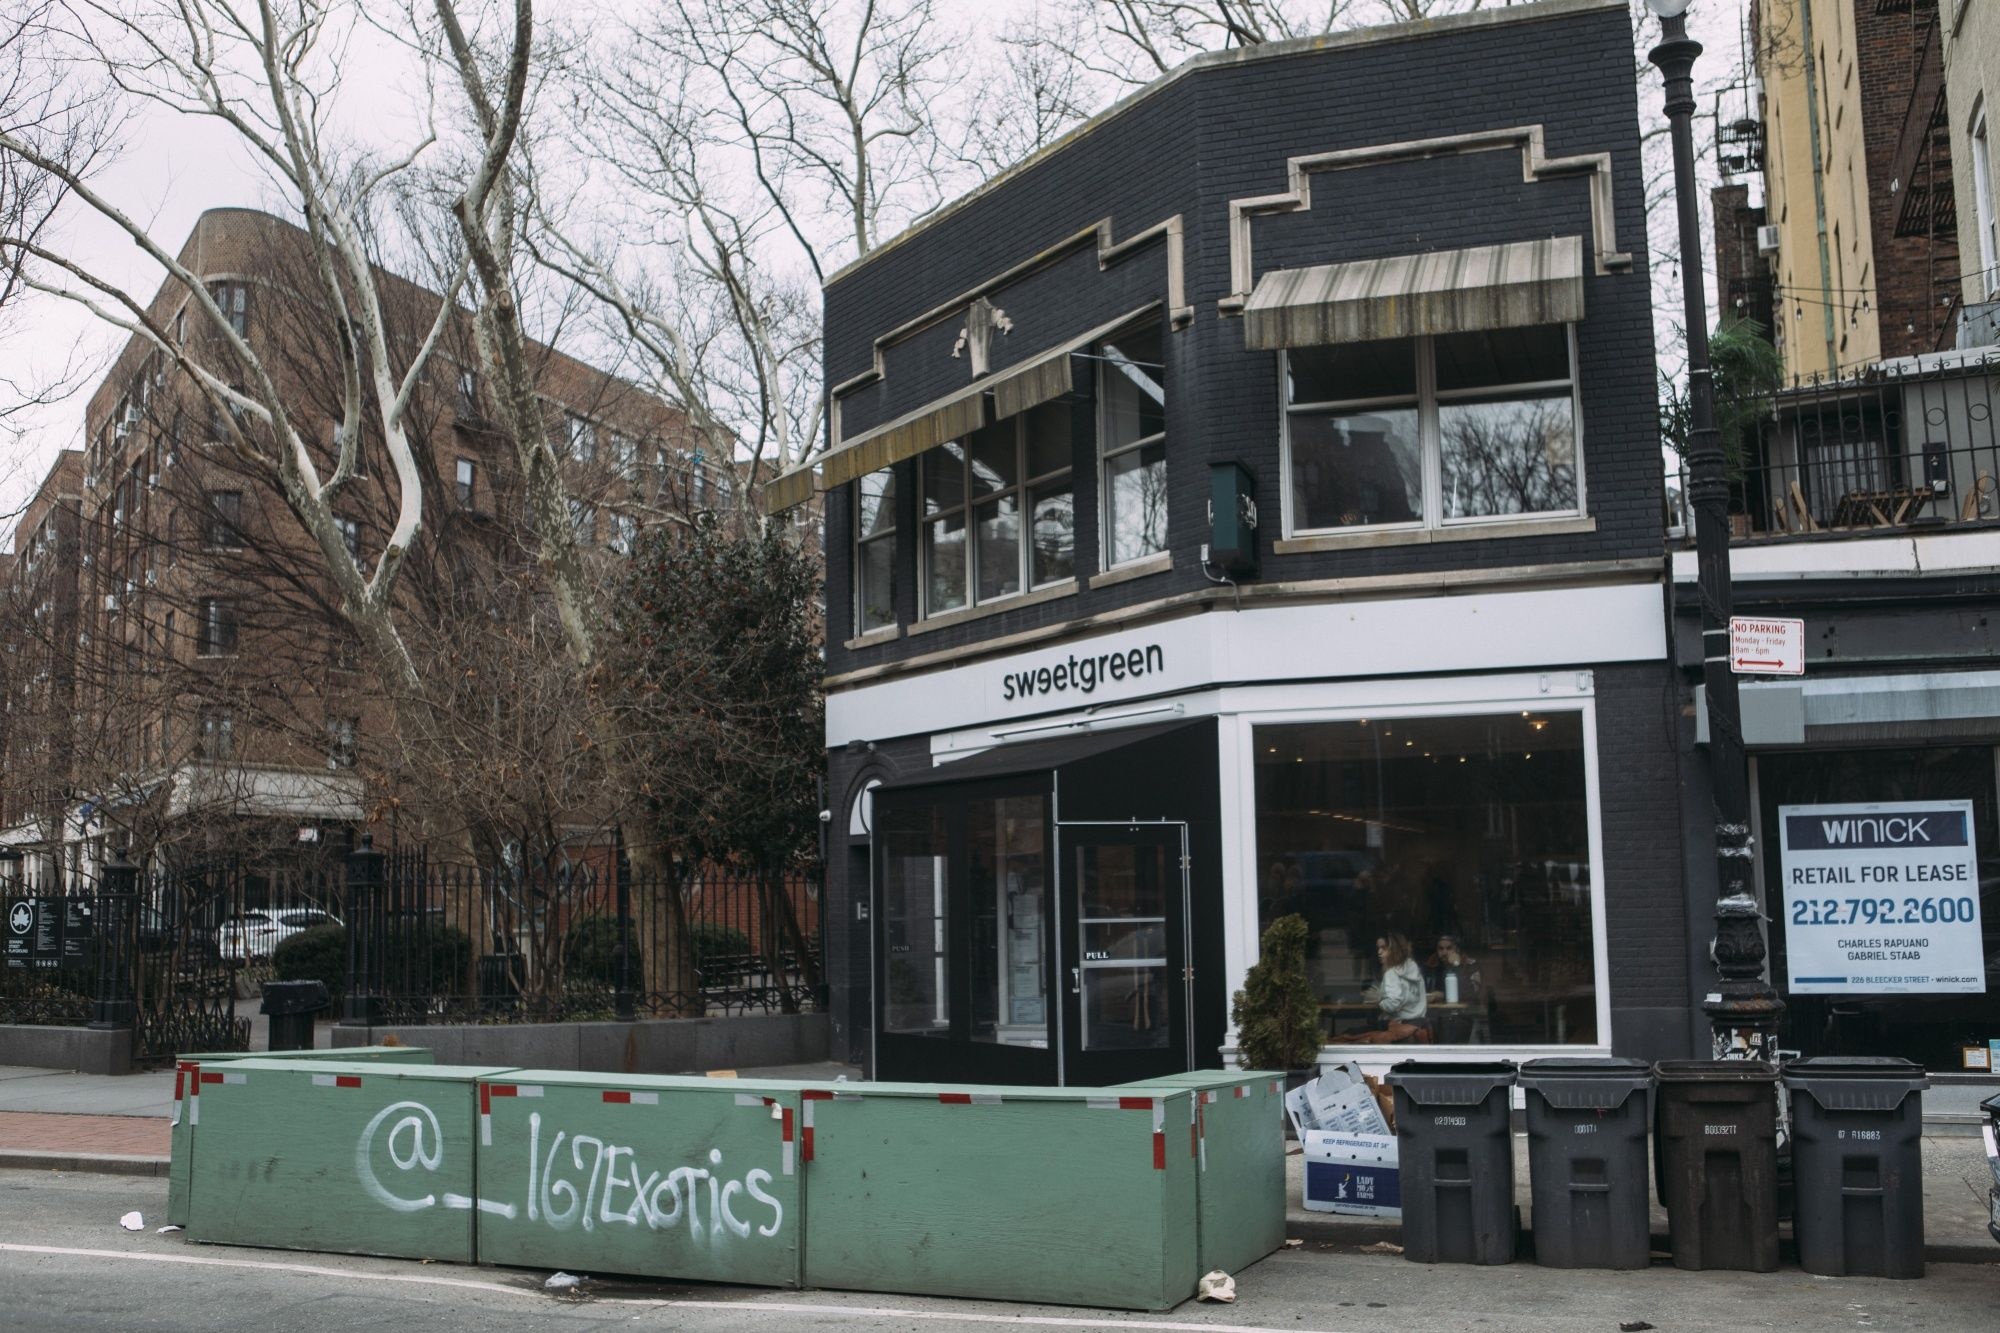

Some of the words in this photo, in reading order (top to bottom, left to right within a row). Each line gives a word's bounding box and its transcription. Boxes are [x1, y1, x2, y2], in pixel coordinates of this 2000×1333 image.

[1735, 623, 1747, 633] NO
[1749, 623, 1786, 635] PARKING
[1735, 636, 1760, 645] Monday
[1766, 637, 1786, 647] Friday
[1755, 647, 1770, 656] 6pm
[1003, 643, 1164, 701] sweetgreen
[1821, 817, 1931, 844] WINICK
[1792, 867, 1856, 885] RETAIL
[1861, 866, 1899, 883] FOR
[1905, 864, 1968, 882] LEASE
[1792, 897, 1975, 926] 212.792.2600
[1837, 939, 1882, 949] CHARLES
[1884, 938, 1929, 948] RAPUANO
[1086, 951, 1109, 959] PULL
[1847, 952, 1888, 961] GABRIEL
[1890, 951, 1921, 960] STAAB
[1851, 976, 1865, 984] 226
[1866, 976, 1903, 984] BLEECKER
[1336, 1139, 1373, 1148] REFRIGERATED
[1356, 1175, 1374, 1185] LADY
